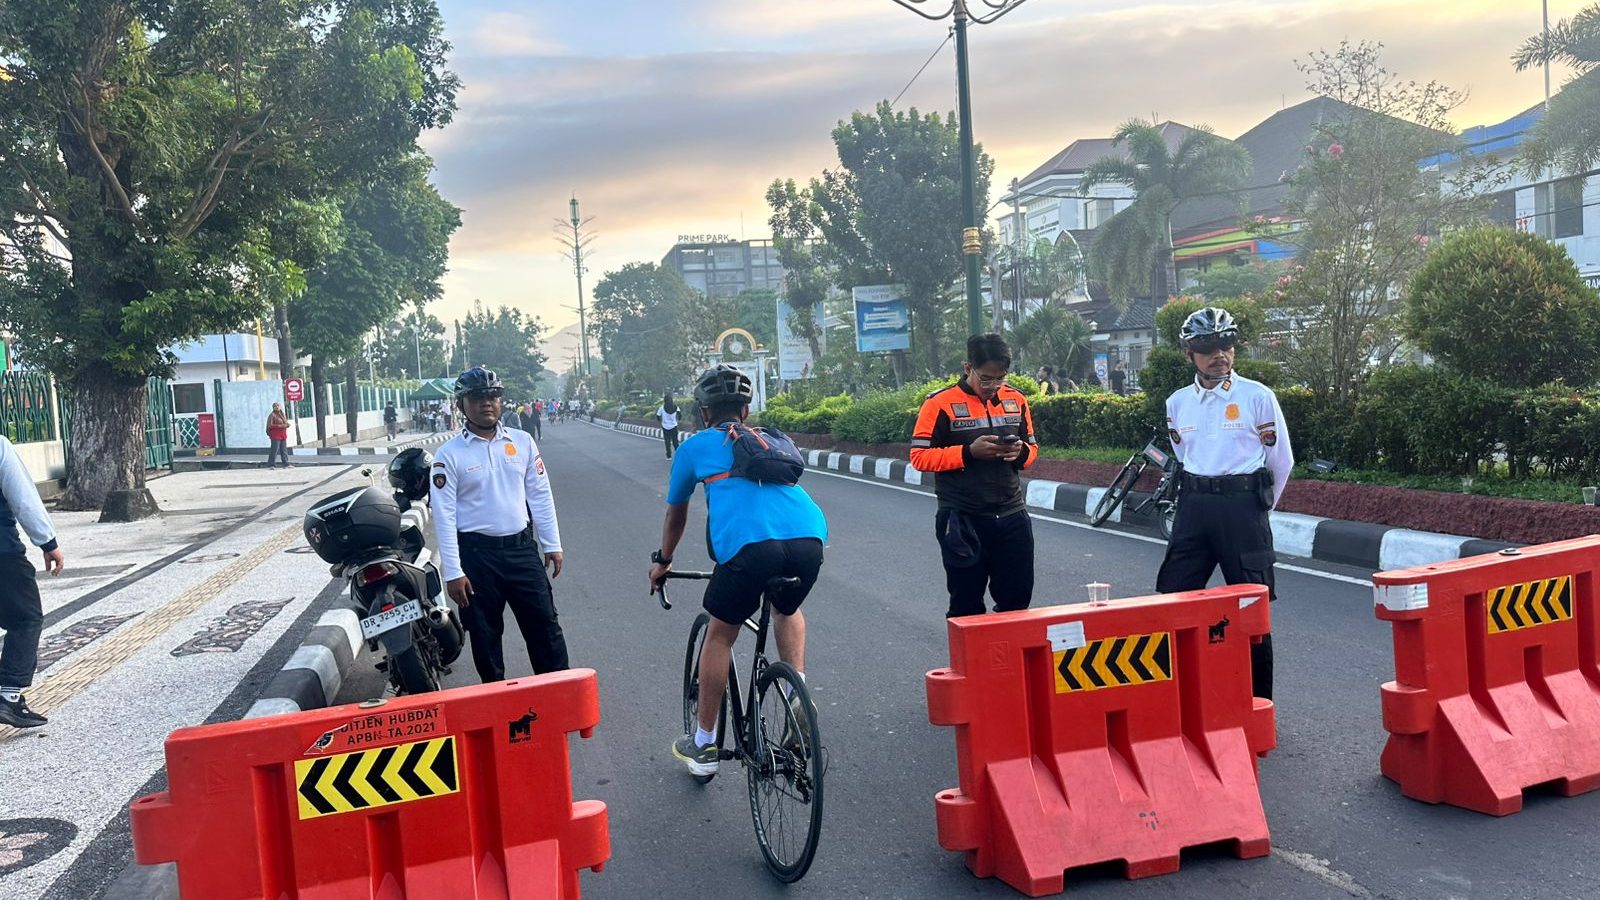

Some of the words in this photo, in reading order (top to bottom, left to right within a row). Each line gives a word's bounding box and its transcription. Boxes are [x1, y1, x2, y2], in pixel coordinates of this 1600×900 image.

[678, 234, 705, 242] PRIME
[323, 506, 345, 517] SHAD
[363, 617, 376, 628] DR
[402, 602, 416, 612] CW
[389, 707, 439, 725] HUBDAT
[388, 722, 435, 738] TA.2021
